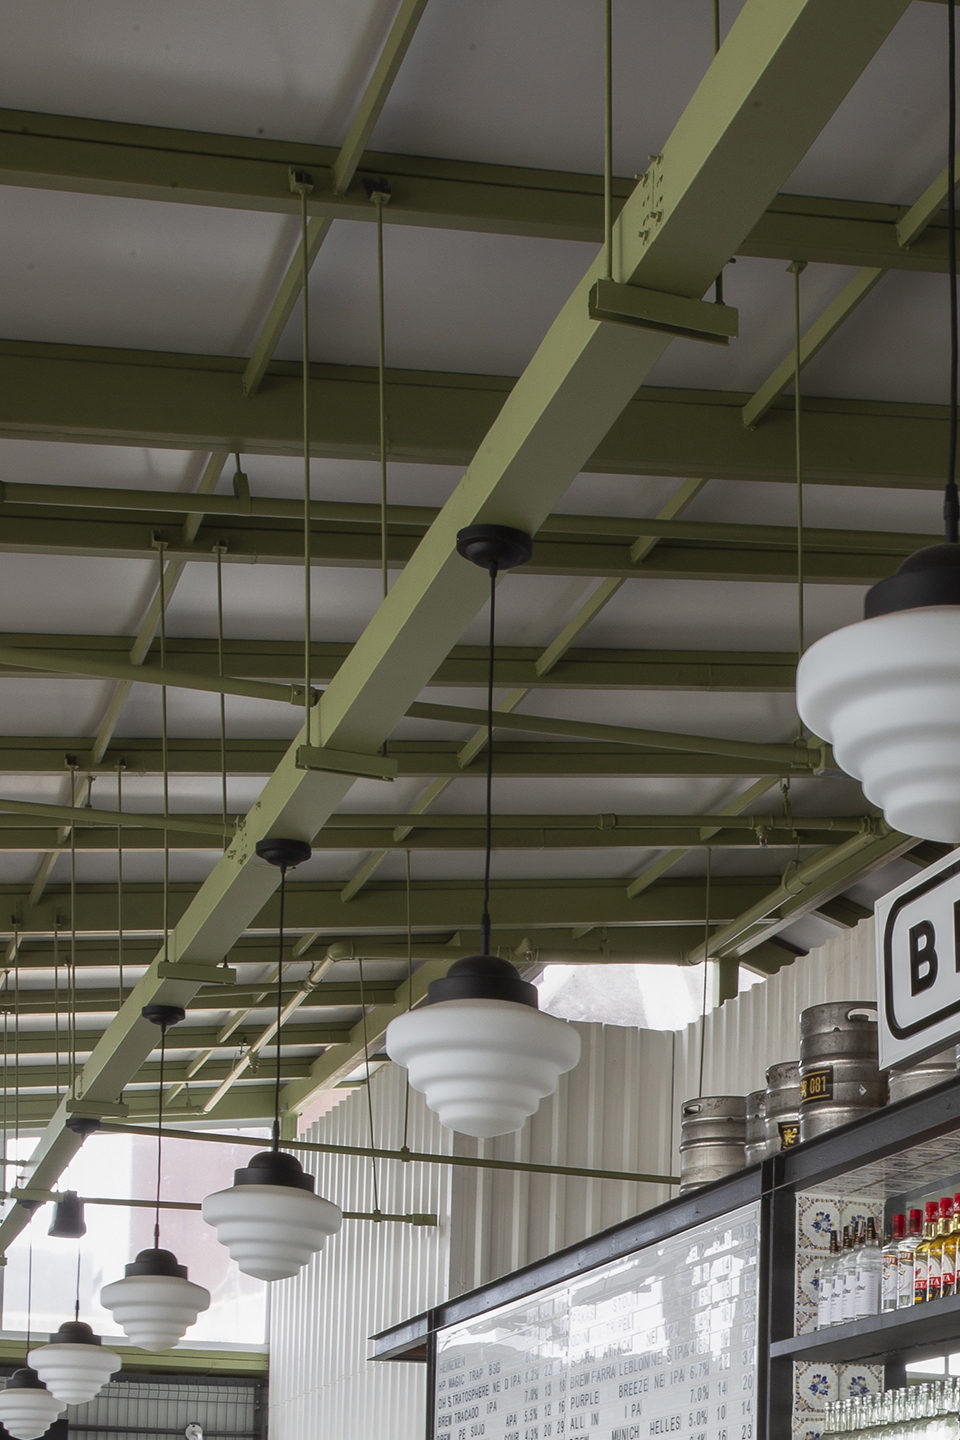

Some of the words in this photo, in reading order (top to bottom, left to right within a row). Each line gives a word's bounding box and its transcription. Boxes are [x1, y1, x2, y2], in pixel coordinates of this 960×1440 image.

[810, 1076, 826, 1094] 081
[469, 1368, 483, 1382] TRAP
[570, 1372, 590, 1390] BREW
[591, 1365, 616, 1383] FARRA
[571, 1391, 599, 1410] PURPLE
[619, 1378, 648, 1399] BREEZE
[654, 1373, 664, 1389] NE
[670, 1368, 685, 1385] IPA
[690, 1361, 709, 1380] 6.7%
[487, 1401, 498, 1414] IPA
[570, 1415, 584, 1430] ALL
[591, 1412, 599, 1426] IN
[690, 1385, 709, 1403] 7.0%
[718, 1380, 726, 1395] 14
[742, 1374, 753, 1390] 20
[471, 1423, 485, 1437] SUJO
[506, 1414, 518, 1427] APA
[650, 1416, 681, 1436] HELLES
[688, 1409, 707, 1427] 5.0%
[717, 1405, 726, 1421] 10
[741, 1400, 751, 1415] 14
[741, 1424, 752, 1440] 23
